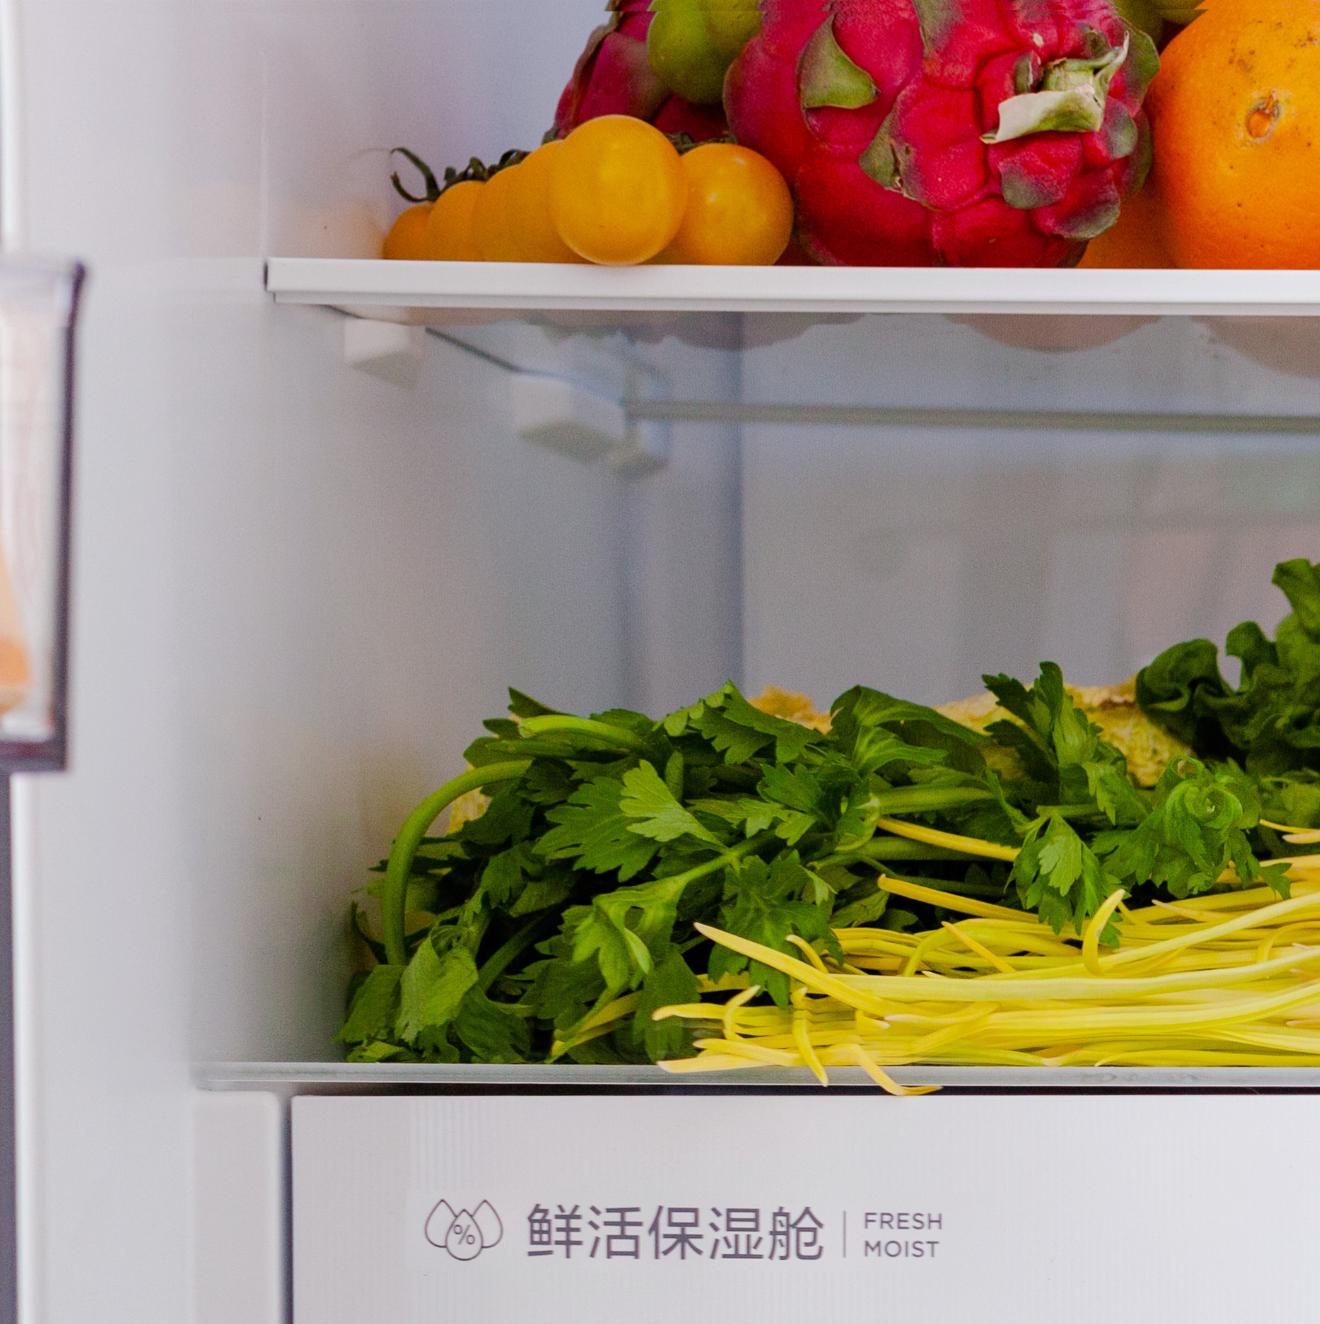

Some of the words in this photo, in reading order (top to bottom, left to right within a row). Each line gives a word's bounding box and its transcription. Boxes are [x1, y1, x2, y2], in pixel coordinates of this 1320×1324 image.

[863, 1212, 943, 1230] FRESH
[527, 1203, 824, 1261] 鲜活保湿舱
[863, 1240, 940, 1258] MOIST
